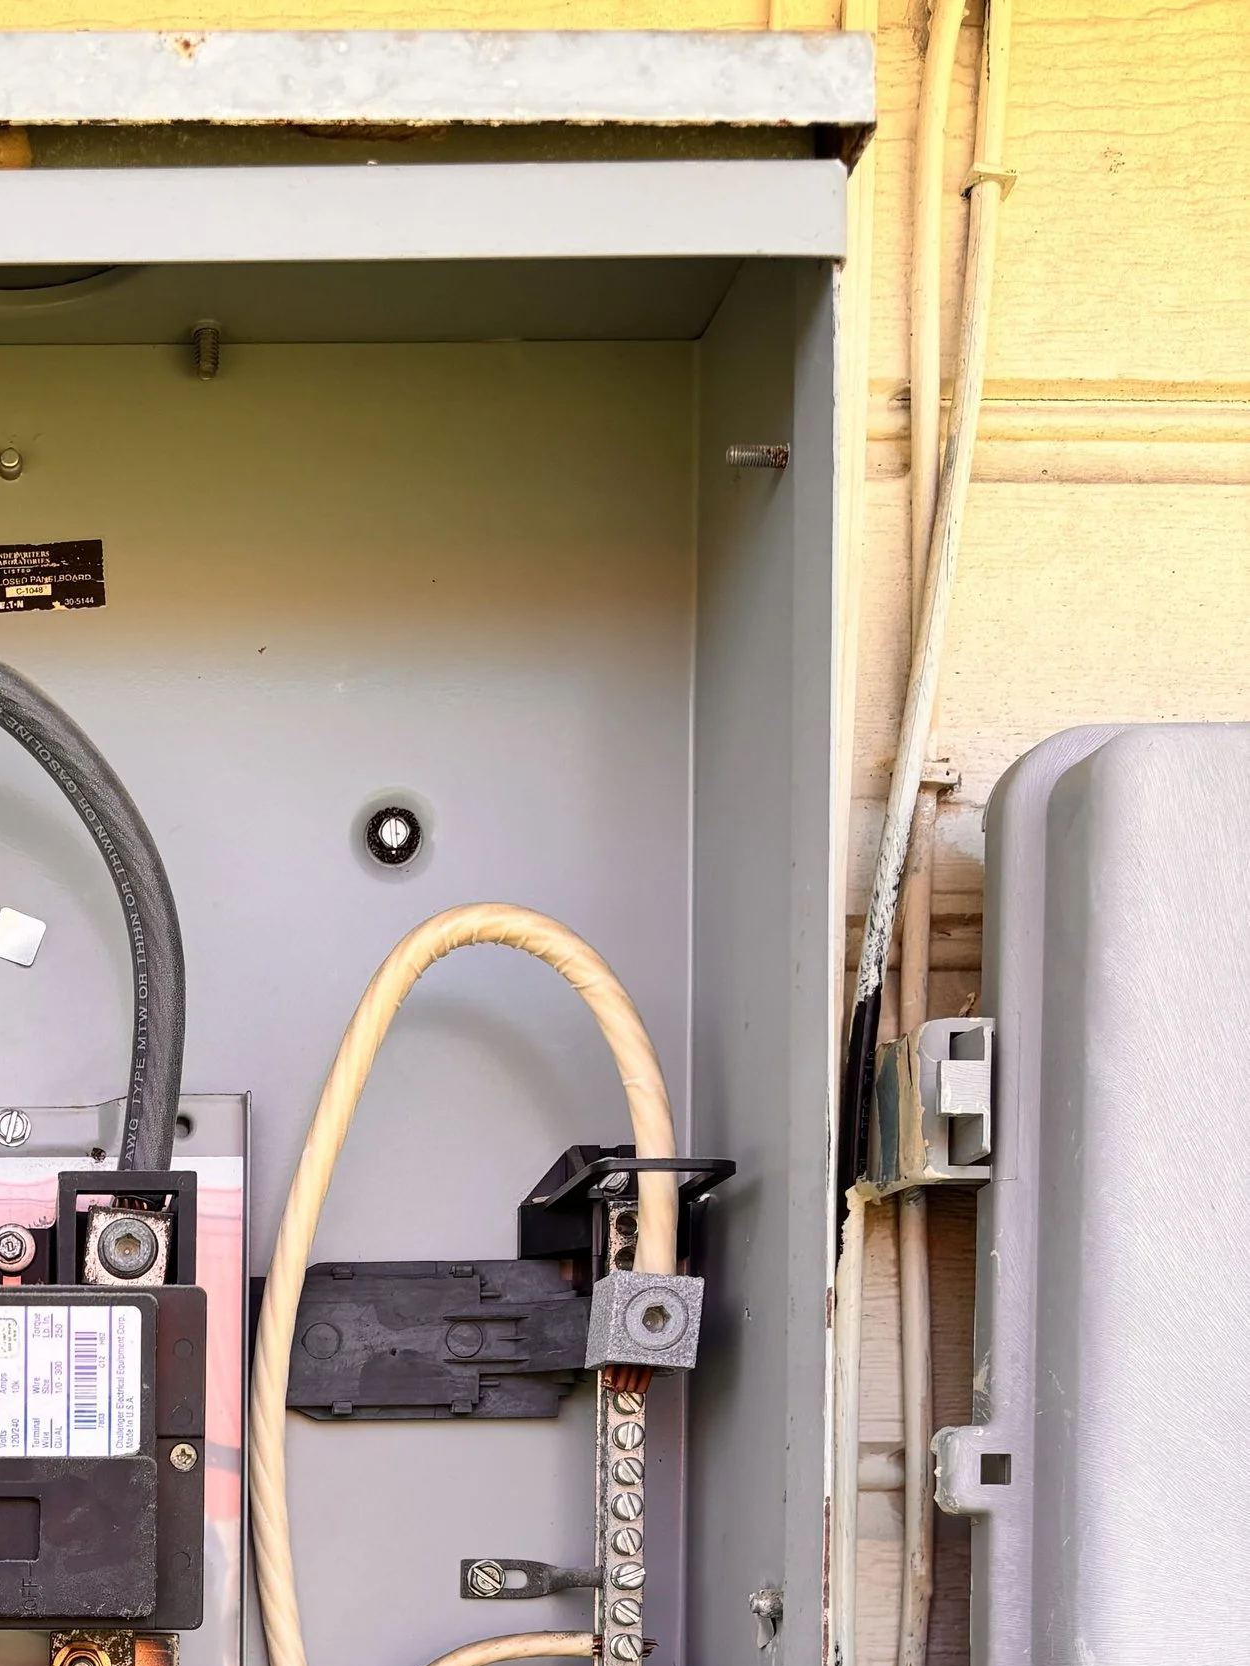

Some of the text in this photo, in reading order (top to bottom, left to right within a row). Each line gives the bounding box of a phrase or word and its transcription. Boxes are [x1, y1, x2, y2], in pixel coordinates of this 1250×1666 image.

[15, 586, 44, 595] C-1048
[64, 596, 94, 606] 30-5144
[5, 715, 149, 1104] TYPE MTW THHN THWN GASOLINE
[32, 1312, 41, 1338] Torque
[55, 1323, 63, 1338] 250
[0, 1372, 8, 1394] Amps
[11, 1380, 20, 1394] 10k
[32, 1376, 40, 1394] Wire
[42, 1379, 50, 1394] Size
[116, 1314, 126, 1449] Challenger Electrical Equipment Corp.
[0, 1430, 7, 1448] Volts
[11, 1418, 20, 1448] 120/240
[32, 1417, 40, 1448] Terminal
[126, 1429, 134, 1449] Made
[23, 1577, 39, 1615] OFF
